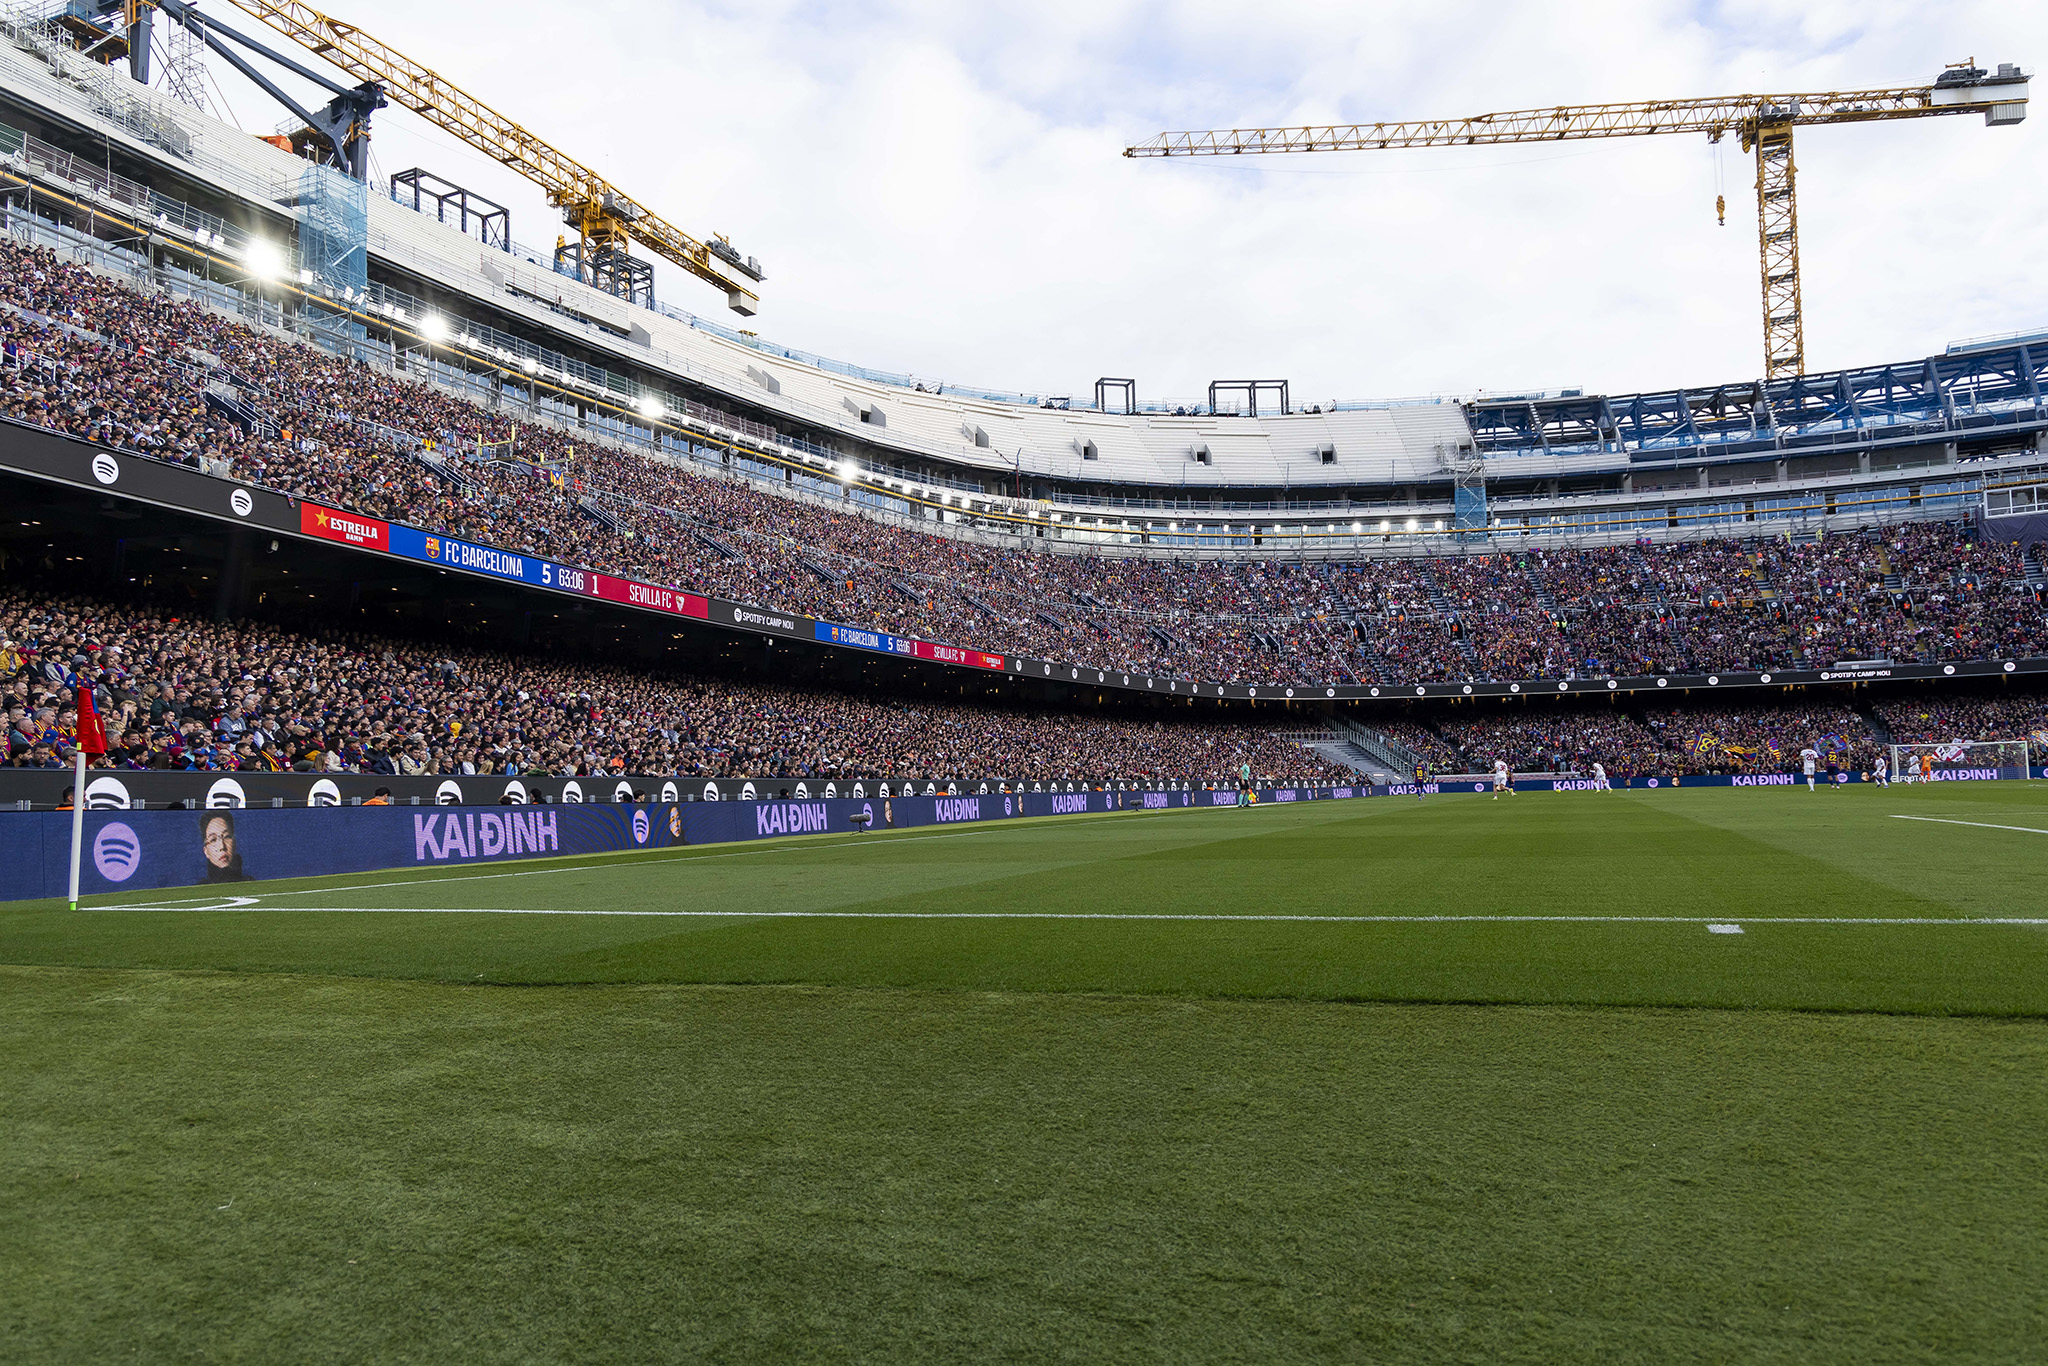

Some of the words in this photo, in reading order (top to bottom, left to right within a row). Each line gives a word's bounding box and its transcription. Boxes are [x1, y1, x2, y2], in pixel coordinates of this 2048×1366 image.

[330, 517, 378, 539] ESTRELLA
[345, 533, 364, 543] DAMM
[445, 541, 459, 563] FC
[461, 545, 523, 578] BARCELONA
[542, 564, 551, 584] 5
[558, 568, 584, 590] 63:06
[592, 575, 599, 595] 1
[629, 585, 661, 607] SEVILLA
[661, 592, 671, 609] FC
[742, 611, 766, 624] SPOTIFY
[766, 616, 782, 627] CAMP
[782, 620, 794, 630] NOU
[840, 629, 848, 642] FC
[848, 630, 879, 648] BARCELONA
[887, 637, 893, 650] 5
[913, 642, 918, 655] 1
[933, 646, 951, 660] SEVILLA
[951, 649, 958, 661] FC
[1830, 671, 1856, 679] SPOTIFY
[1857, 670, 1876, 678] CAMP
[1805, 753, 1815, 761] 20
[1828, 754, 1837, 762] 22
